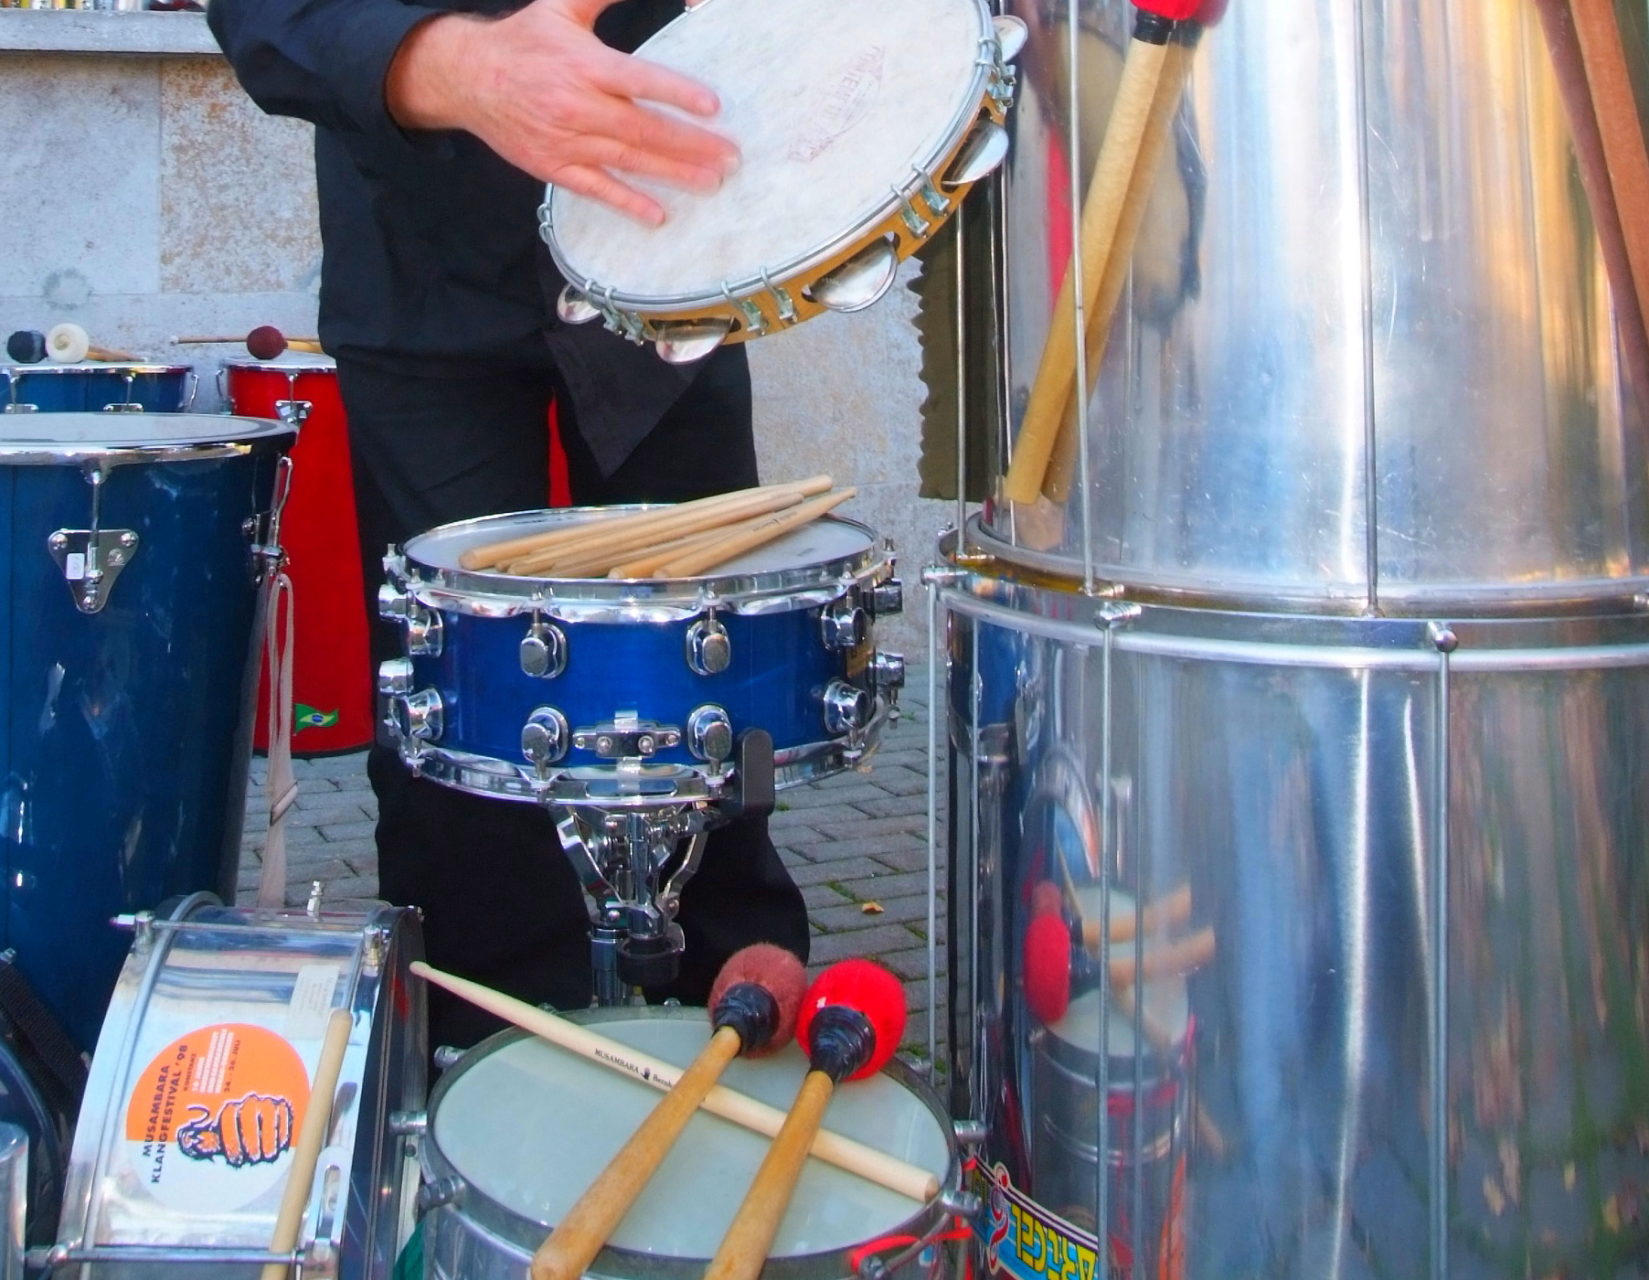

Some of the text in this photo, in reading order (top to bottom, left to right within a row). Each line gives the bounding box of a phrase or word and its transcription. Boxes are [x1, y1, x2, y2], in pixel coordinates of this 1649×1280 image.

[594, 1048, 639, 1073] MUSAMBARA
[142, 1065, 170, 1157] MUSAMBARA
[151, 1071, 181, 1183] KLANGFESTIVAL
